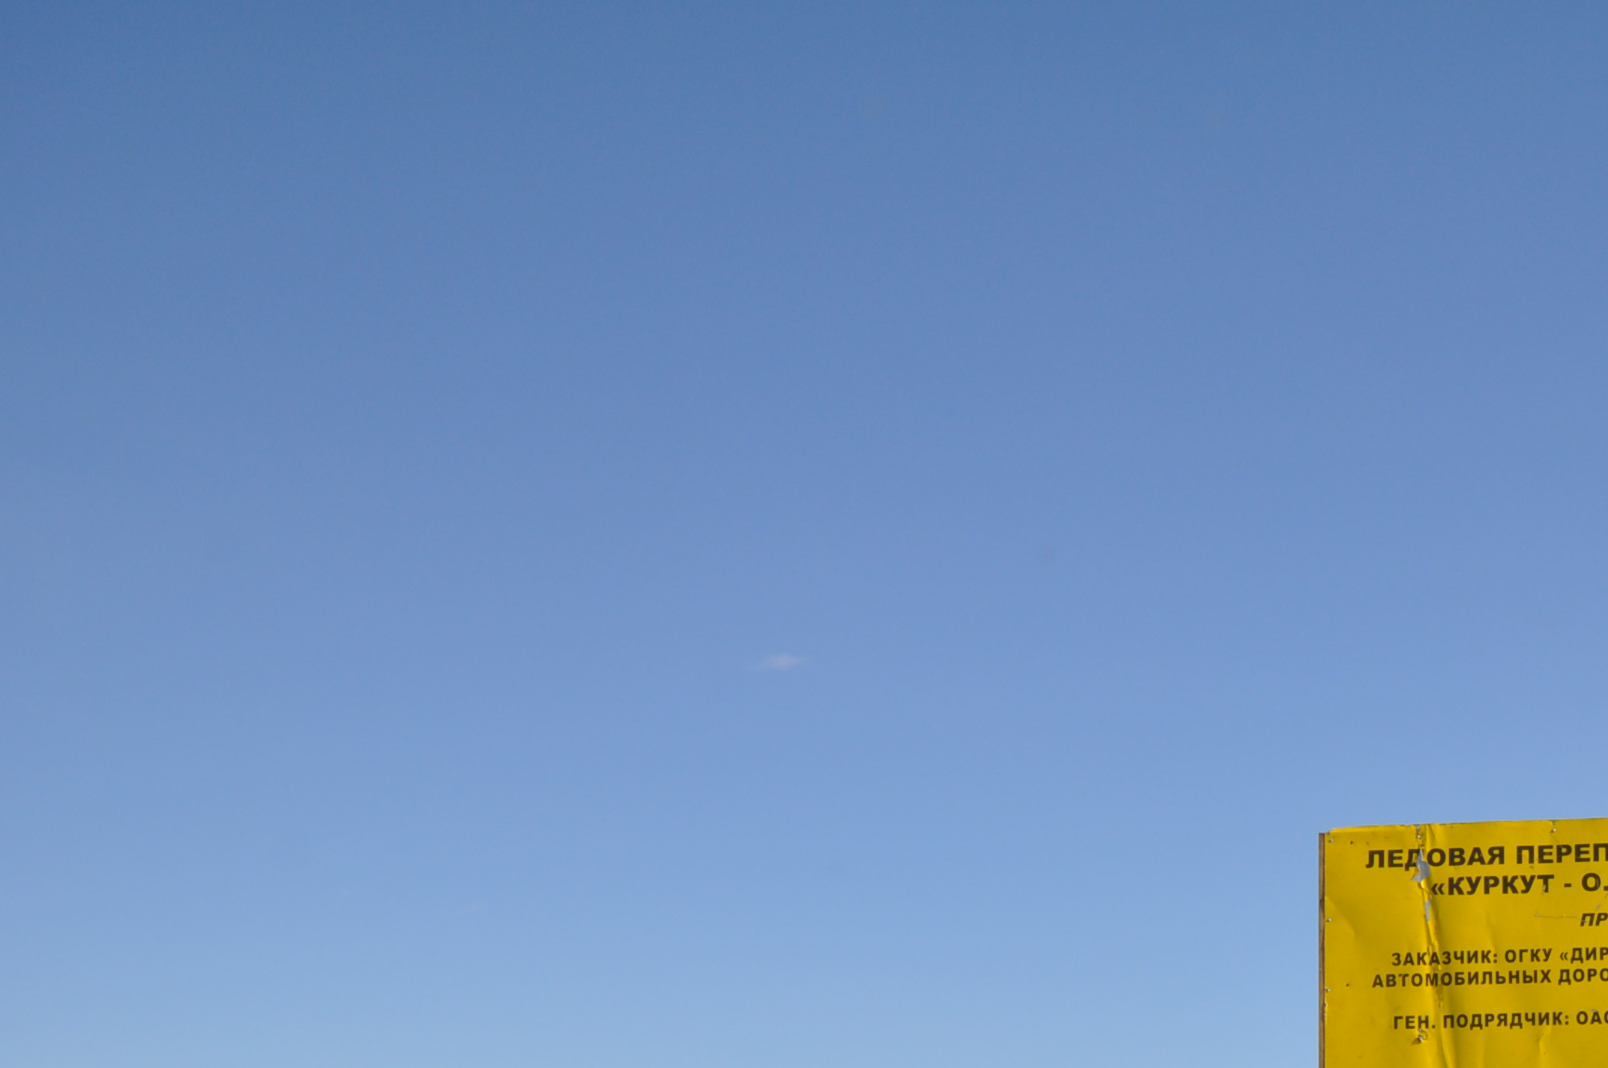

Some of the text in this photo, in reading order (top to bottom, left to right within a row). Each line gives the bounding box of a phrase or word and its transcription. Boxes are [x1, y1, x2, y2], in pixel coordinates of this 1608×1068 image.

[1365, 847, 1505, 871] ЛЕДОВАЯ
[1430, 874, 1555, 896] «КУРКУТ
[1391, 950, 1498, 967] ЗАКАЗЧИК:
[1504, 948, 1552, 964] ОГКУ
[1372, 969, 1552, 988] АВТОМОБИЛЬНЫХ
[1393, 1015, 1436, 1030] ГЕН.
[1443, 1011, 1569, 1031] ПОДРЯДЧИК:
